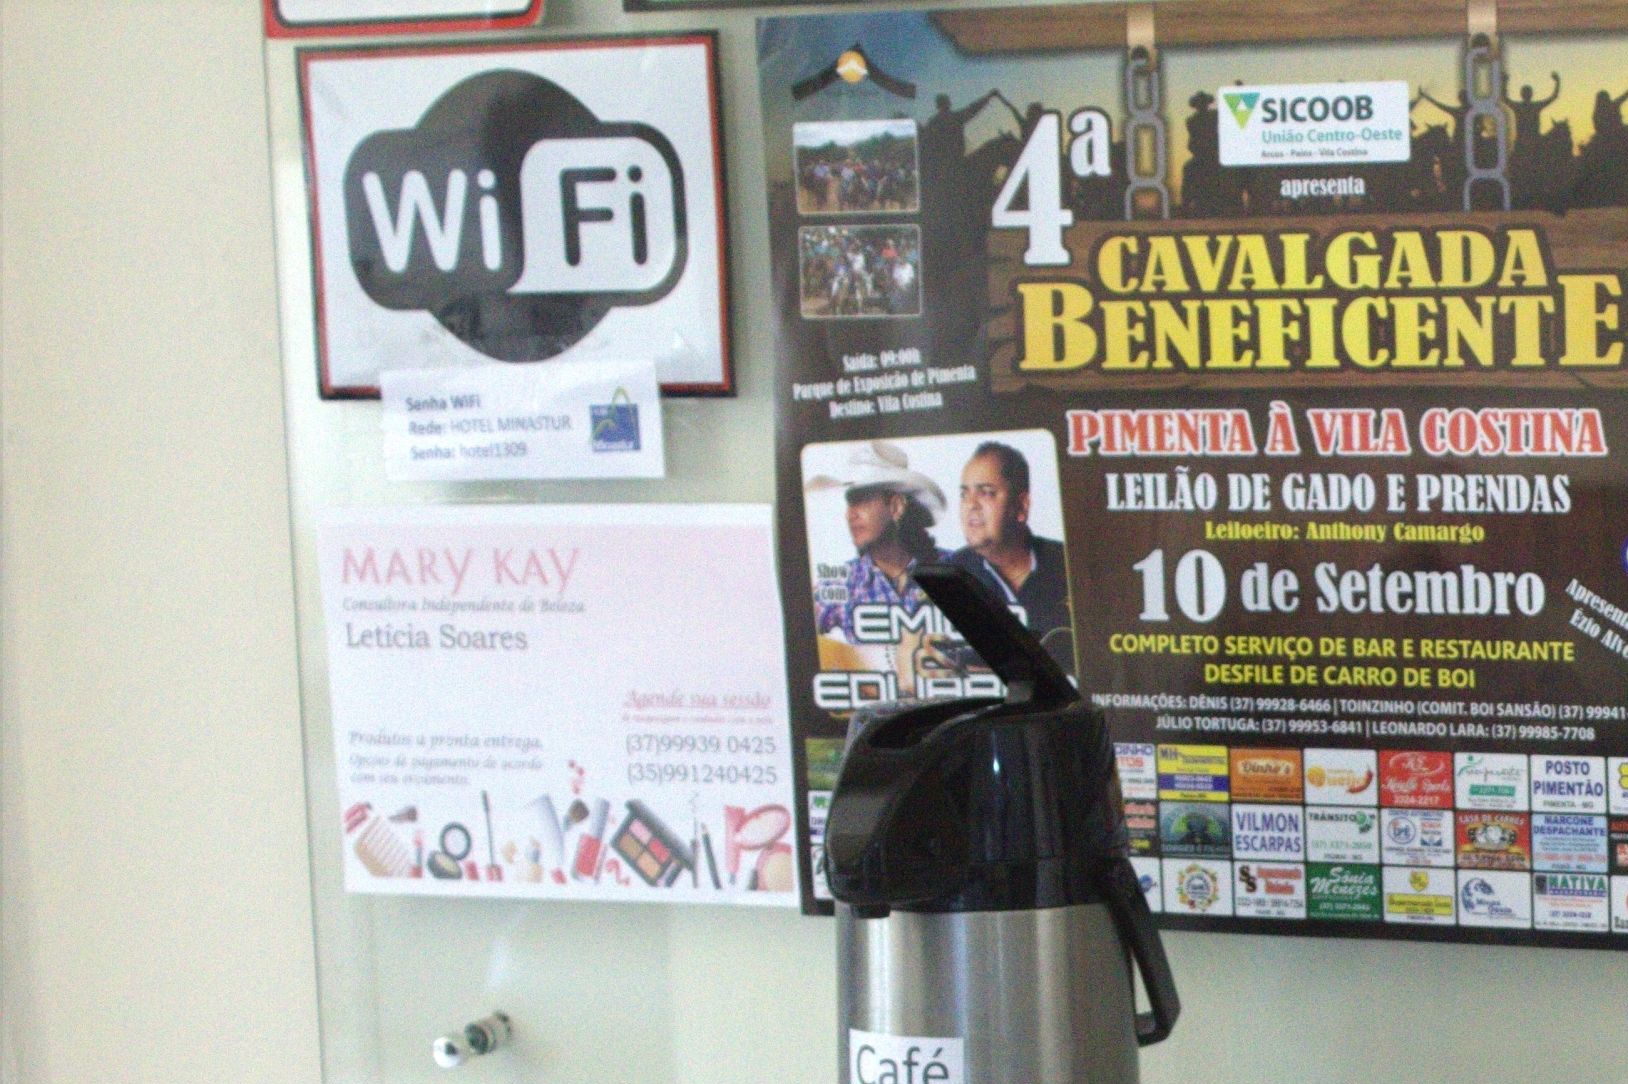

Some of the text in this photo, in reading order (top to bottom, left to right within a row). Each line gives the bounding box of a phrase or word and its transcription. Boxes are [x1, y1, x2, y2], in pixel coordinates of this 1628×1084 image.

[1261, 95, 1374, 123] SICOOB
[1261, 127, 1403, 144] União Centro-Oeste
[1279, 175, 1366, 198] apresenta
[1097, 228, 1549, 293] CAVALGADA
[1017, 274, 1625, 371] BENEFICENTE
[406, 396, 448, 411] Senha
[451, 418, 492, 433] HOTEL
[497, 415, 572, 431] MINASTUR
[1066, 401, 1608, 457] PIMENTA À VILA COSTINA
[1105, 464, 1572, 514] LEILÃO DE GADO E PRENDAS
[1204, 520, 1485, 544] Leiloeiro: Anthony Camargo
[341, 547, 581, 596] MARY KAY
[1132, 548, 1546, 623] 10 de Setembro
[439, 623, 528, 650] Soares
[1109, 632, 1576, 662] COMPLETO SERVIÇO DE BAR RESTAURANTE
[1204, 663, 1476, 689] DESFILE DE CARRO DE BOI
[1092, 692, 1187, 713] INFORMAÇÕES:
[1230, 696, 1254, 713] (37)
[1256, 696, 1331, 712] 99928-6466
[1340, 698, 1414, 715] TOINZINHO
[1470, 701, 1494, 716] BOI
[1558, 704, 1583, 720] (37)
[1155, 714, 1596, 741] JÚLIO TORTUGA: (37) 99953-6841 LEONARDO LARA: (37) 99985-7708
[1545, 759, 1590, 775] POSTO
[1533, 779, 1604, 797] PIMENTÃO
[1236, 811, 1300, 832] VILMON
[1533, 826, 1606, 837] DESPACHANTE
[1235, 834, 1301, 853] ESCARPAS
